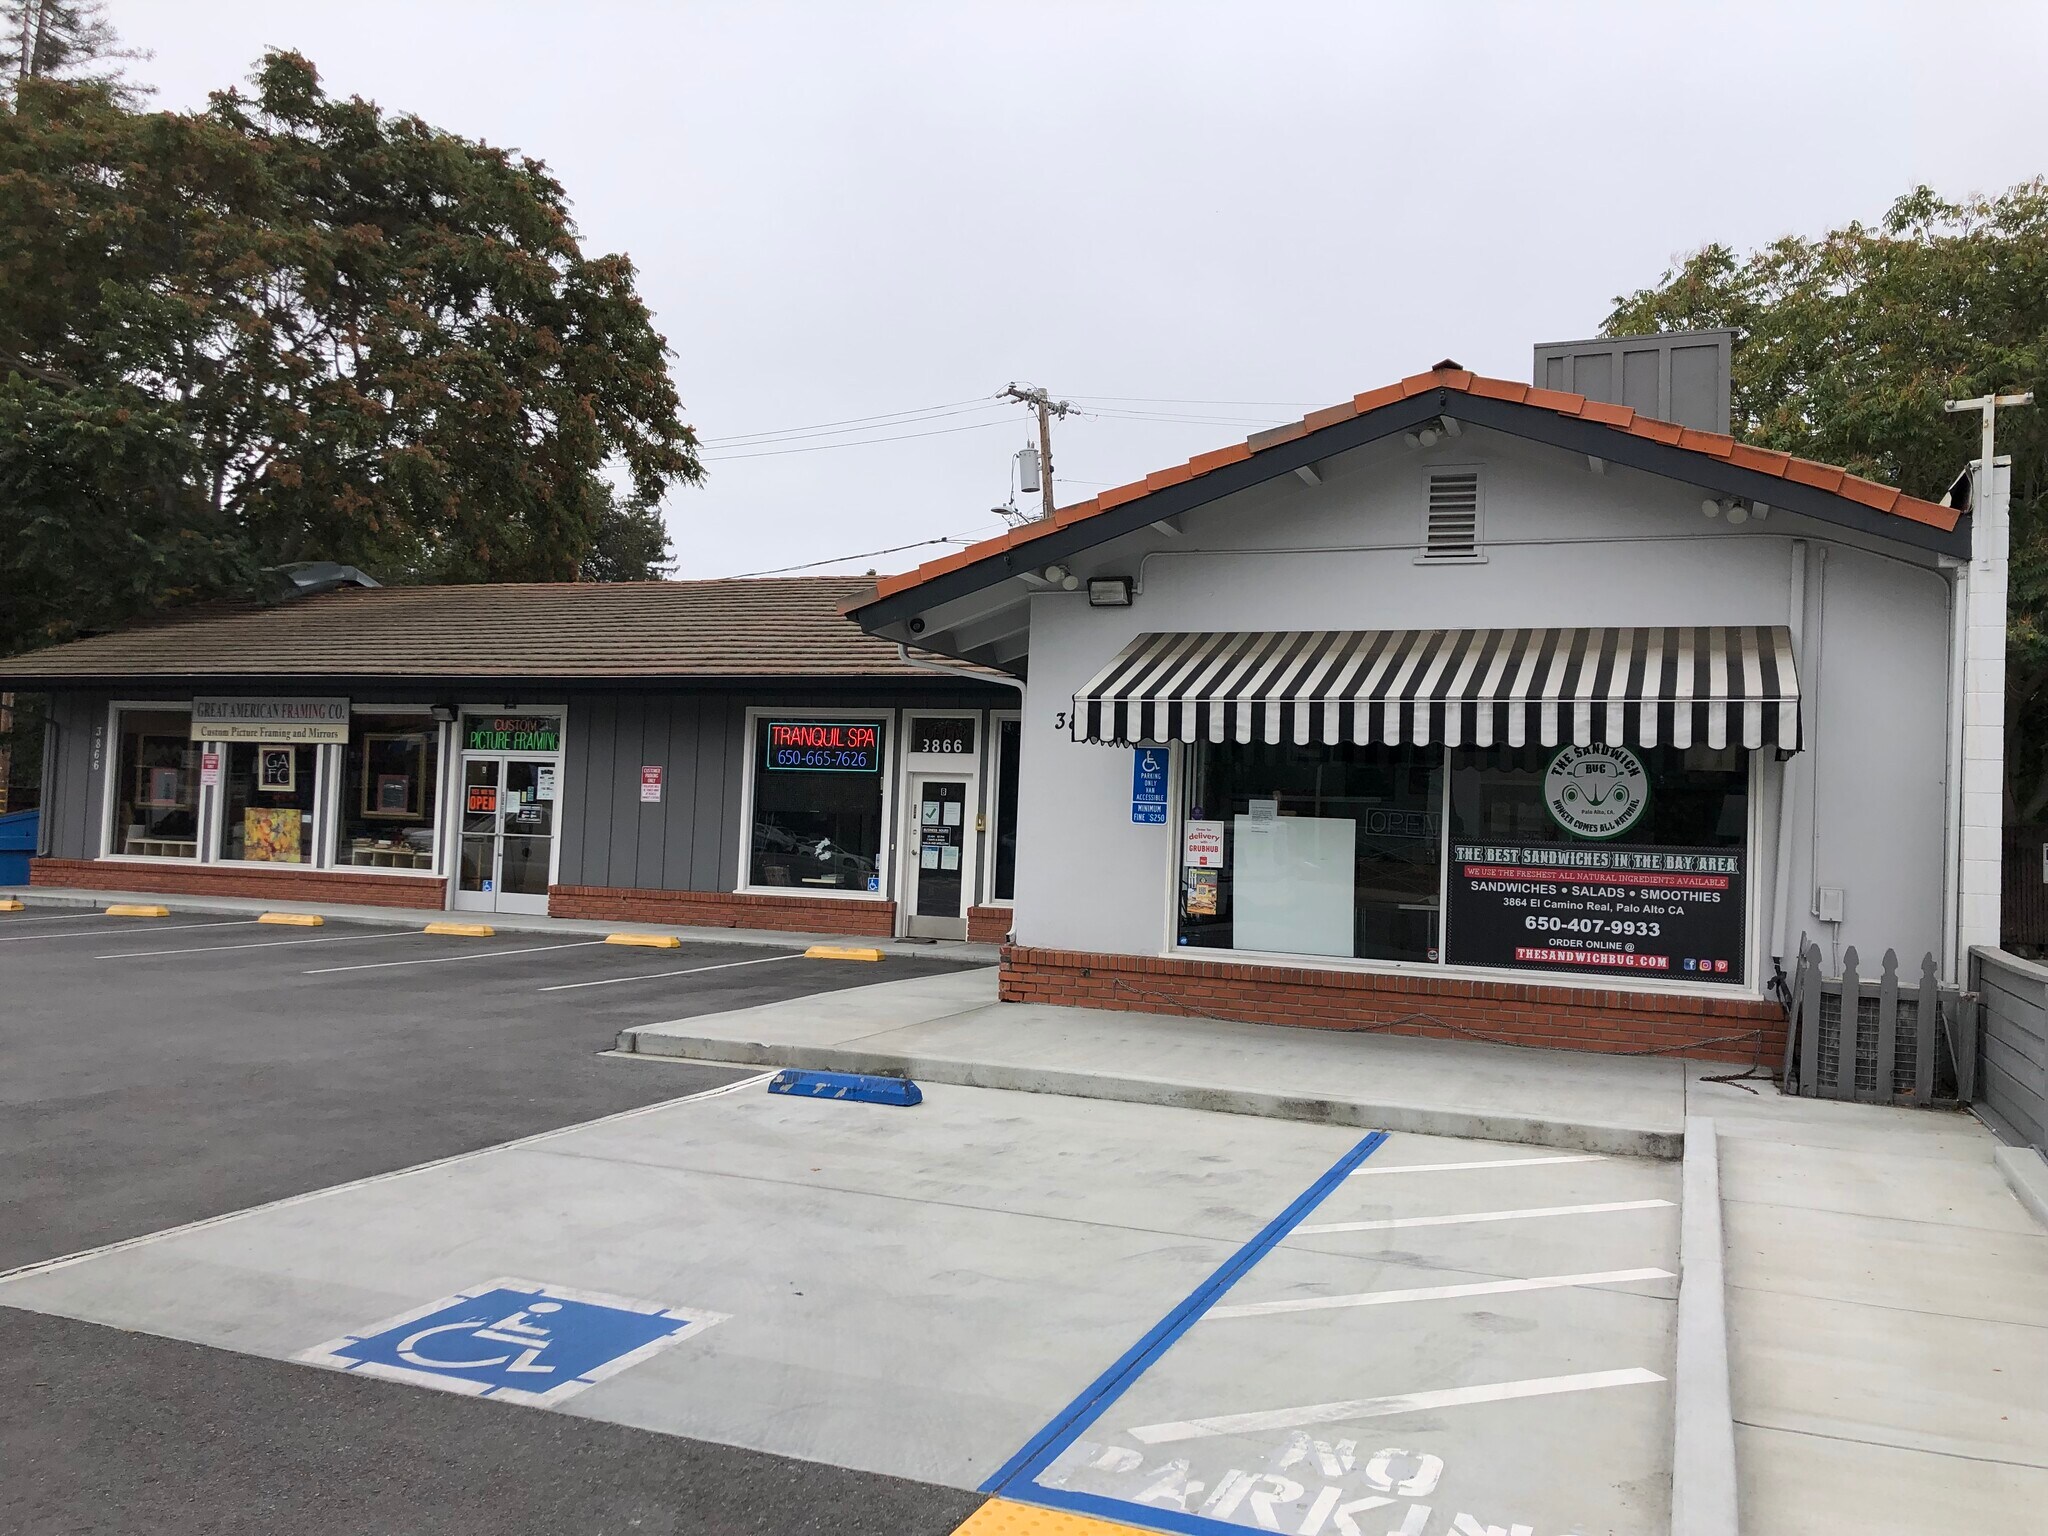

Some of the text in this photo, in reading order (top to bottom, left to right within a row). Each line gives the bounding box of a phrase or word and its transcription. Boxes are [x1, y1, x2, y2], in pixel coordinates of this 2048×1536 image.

[197, 702, 345, 720] GREAT AMERICAN FRAMING CO.
[201, 726, 339, 740] Custom Picture Framing and Mirrors
[494, 719, 537, 731] CUSTOM
[470, 731, 560, 751] PICTURE FRAMING
[772, 726, 875, 748] TRANQUIL SPA
[922, 738, 962, 753] 3866
[93, 726, 102, 770] 3866
[266, 753, 289, 768] GA
[778, 749, 868, 767] 650-665-7626
[1551, 743, 1641, 777] THE SANDWICH
[268, 768, 289, 783] FC
[1140, 772, 1161, 780] PARKING
[1585, 763, 1606, 774] BUG
[469, 796, 496, 811] OPEN
[1137, 804, 1162, 813] MINIMUM
[1133, 813, 1146, 821] FINE
[1370, 811, 1439, 836] OPEN
[1573, 819, 1598, 833] COMES
[1599, 822, 1615, 833] ALL
[1614, 798, 1640, 827] NATURAL
[1188, 832, 1220, 842] delivery
[1188, 844, 1219, 853] GRUBHUB
[1456, 846, 1736, 872] THE BEST SANDWICHES IN THE BAY AREA
[1467, 867, 1726, 887] WE USE THE FRESHEST ALL NATURAL INGREDIENTS AVAILABLE
[1470, 880, 1721, 903] SANDWICHES SALADS SMOOTHIES
[1503, 897, 1685, 915] 3864 El Camino Real, Palo Alto CA
[1525, 916, 1661, 937] 650-407-9933
[1548, 938, 1635, 952] ORDER ONLINE @
[1517, 948, 1668, 968] THESANDWICHBUG.COM
[1276, 1430, 1444, 1496] NO
